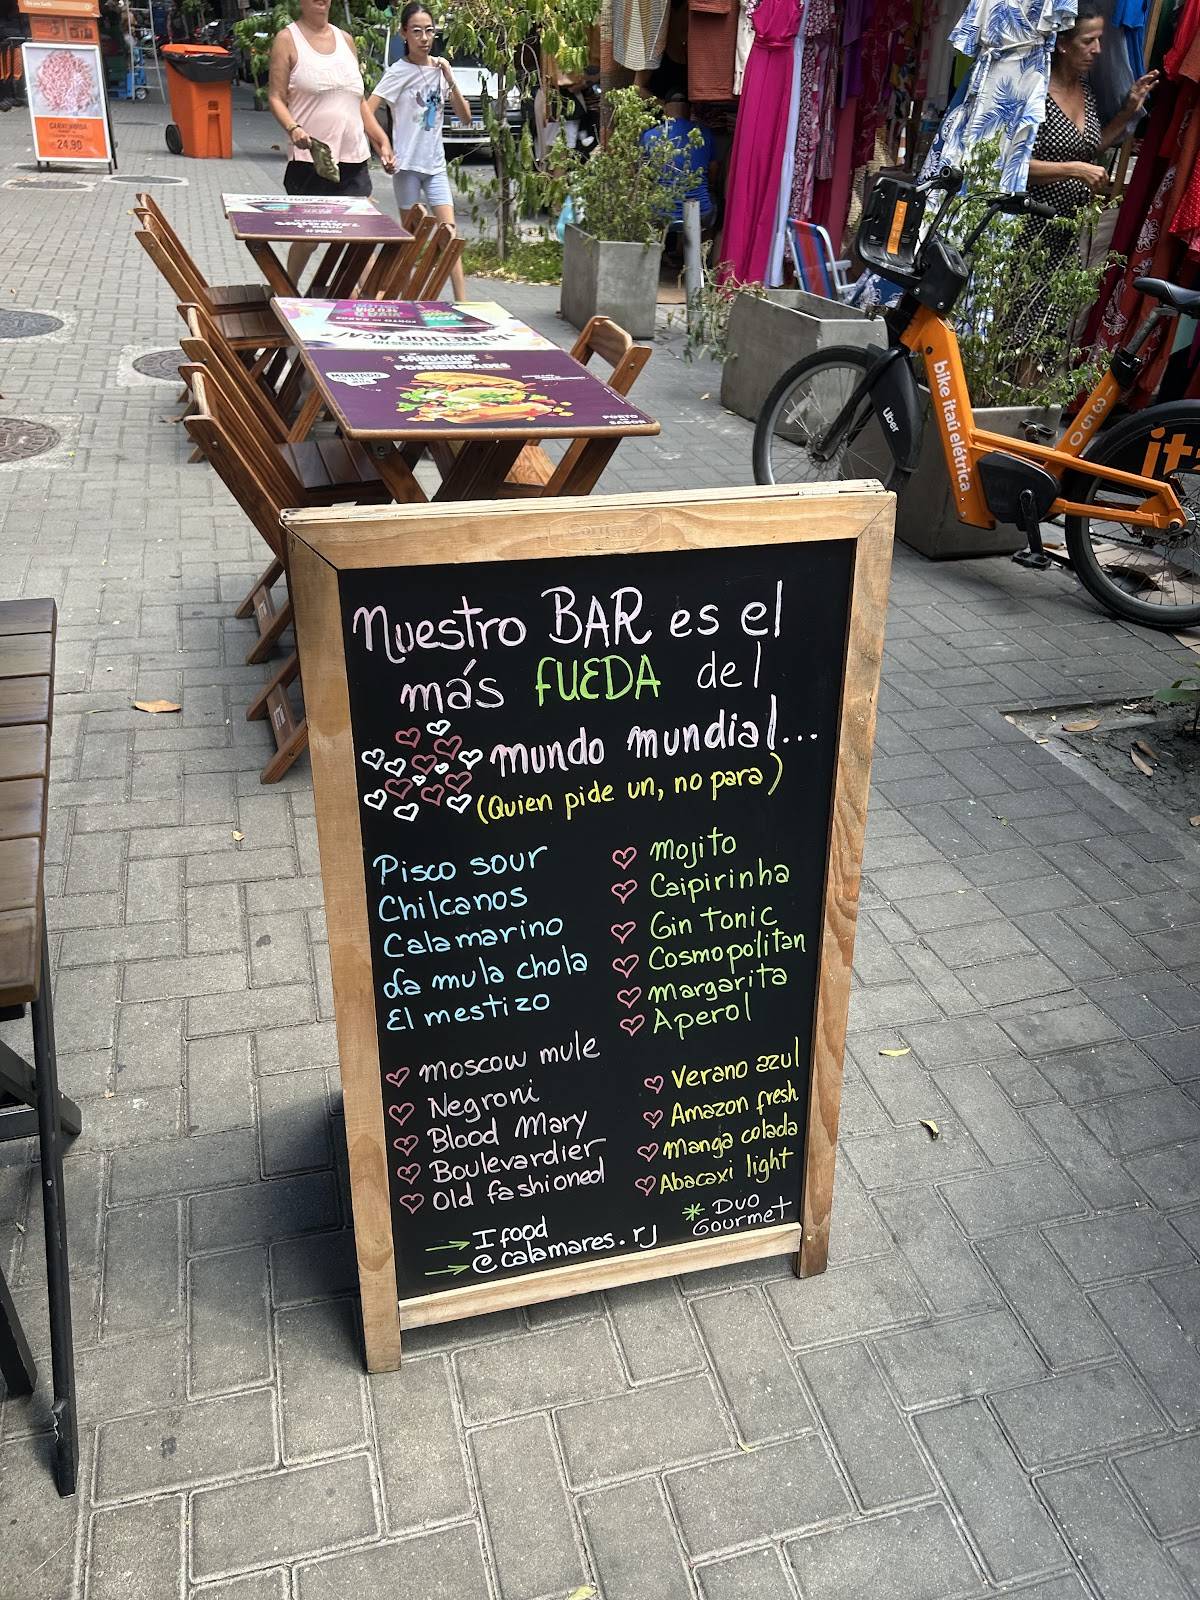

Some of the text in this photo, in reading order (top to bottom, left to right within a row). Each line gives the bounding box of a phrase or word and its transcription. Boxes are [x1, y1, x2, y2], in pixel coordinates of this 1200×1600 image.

[398, 334, 478, 342] MELHOR
[882, 407, 900, 433] Uber
[933, 360, 971, 492] bike itaú elétrica
[1141, 426, 1200, 476] it
[353, 579, 783, 664] Nuestro BAR es el
[400, 658, 505, 713] más
[477, 752, 783, 824] (Quien pide un, no para)
[372, 845, 548, 885] Pisco sour
[650, 857, 790, 904] Caipirinha
[378, 887, 528, 922] Chilcanos
[650, 910, 693, 940] Gin
[383, 917, 563, 958] Calamarino
[648, 927, 806, 975] Cosmopolitan
[431, 956, 505, 991] mula
[516, 944, 588, 981] chola
[386, 993, 550, 1031] El mestizo
[653, 991, 751, 1040] Aperol
[540, 1030, 601, 1065] mule
[671, 1036, 800, 1089] Verano azul
[428, 1079, 540, 1123] Negroni
[671, 1080, 800, 1128] Amazon fresh
[427, 1116, 500, 1154] Blood
[741, 1112, 799, 1144] colada
[428, 1138, 607, 1183] Boulevardier
[432, 1155, 605, 1211] Old fashioned
[659, 1147, 795, 1195] Abacaxi light
[692, 1195, 793, 1236] Gourmet
